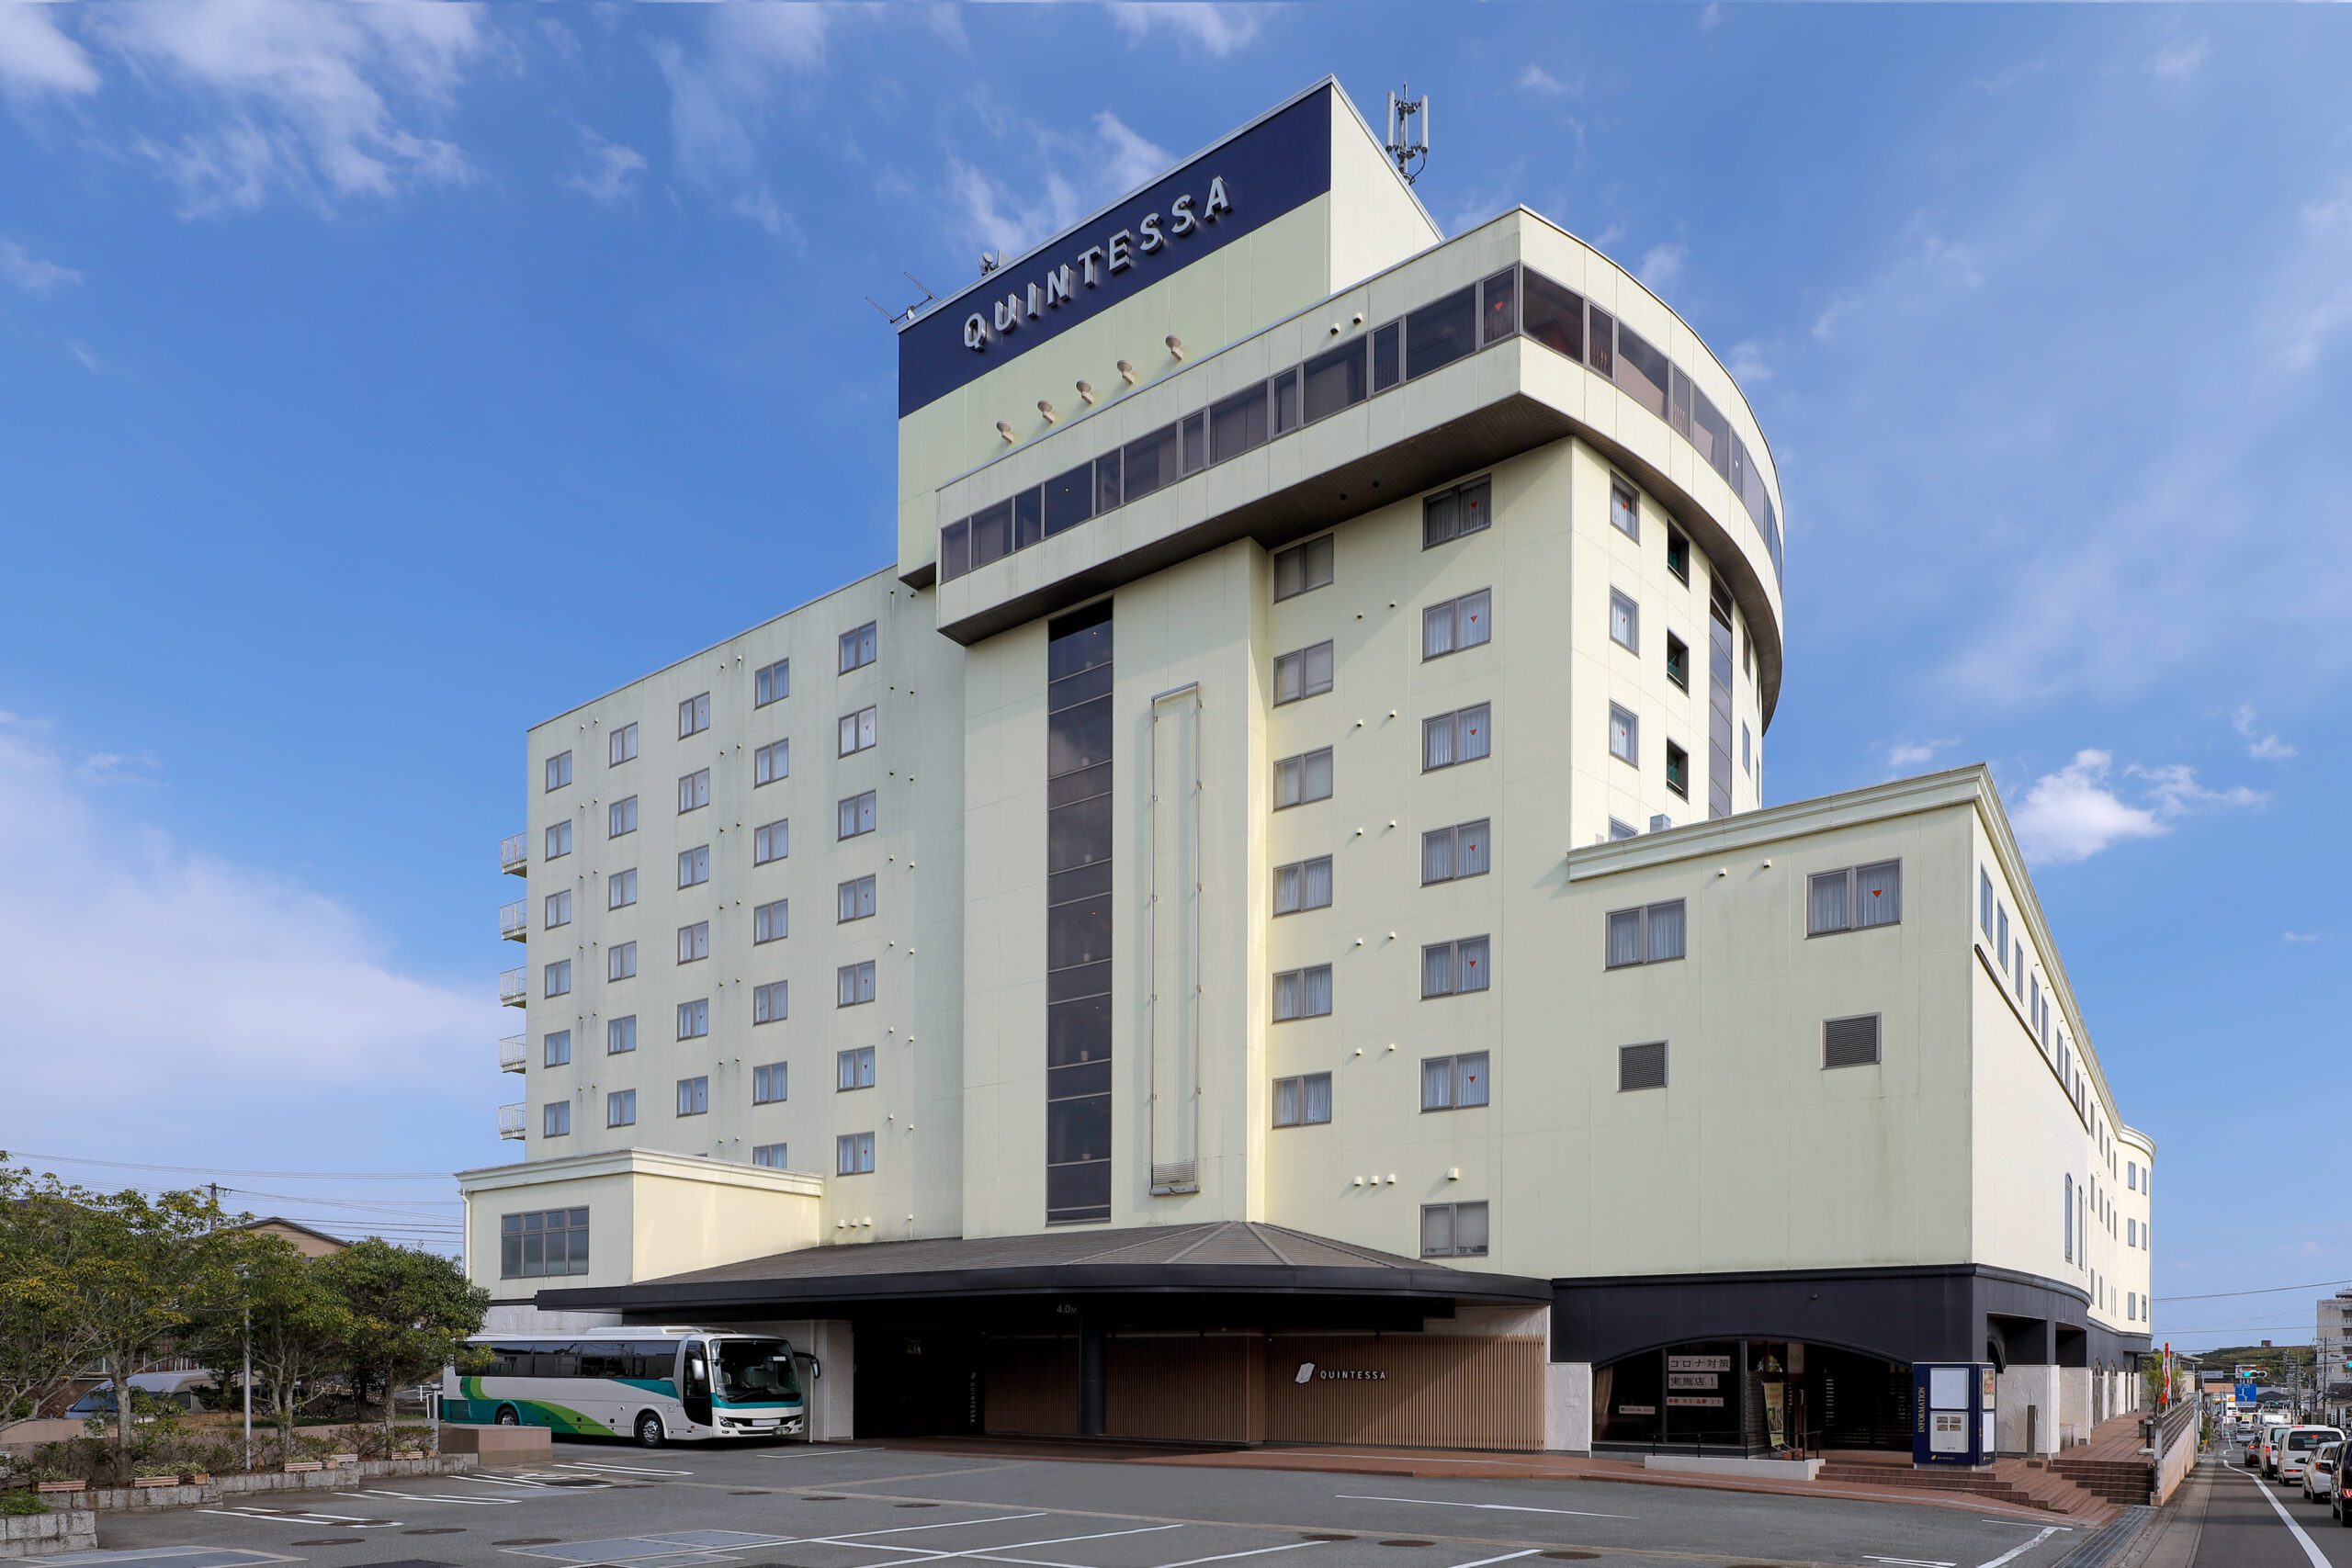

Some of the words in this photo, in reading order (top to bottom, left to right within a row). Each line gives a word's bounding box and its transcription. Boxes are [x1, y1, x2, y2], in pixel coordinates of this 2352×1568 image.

[963, 175, 1233, 353] QUINTESSA
[1320, 1371, 1385, 1380] QUINTESSA
[1670, 1359, 1729, 1369] コロナ対策
[1917, 1386, 1926, 1433] INFORMATION
